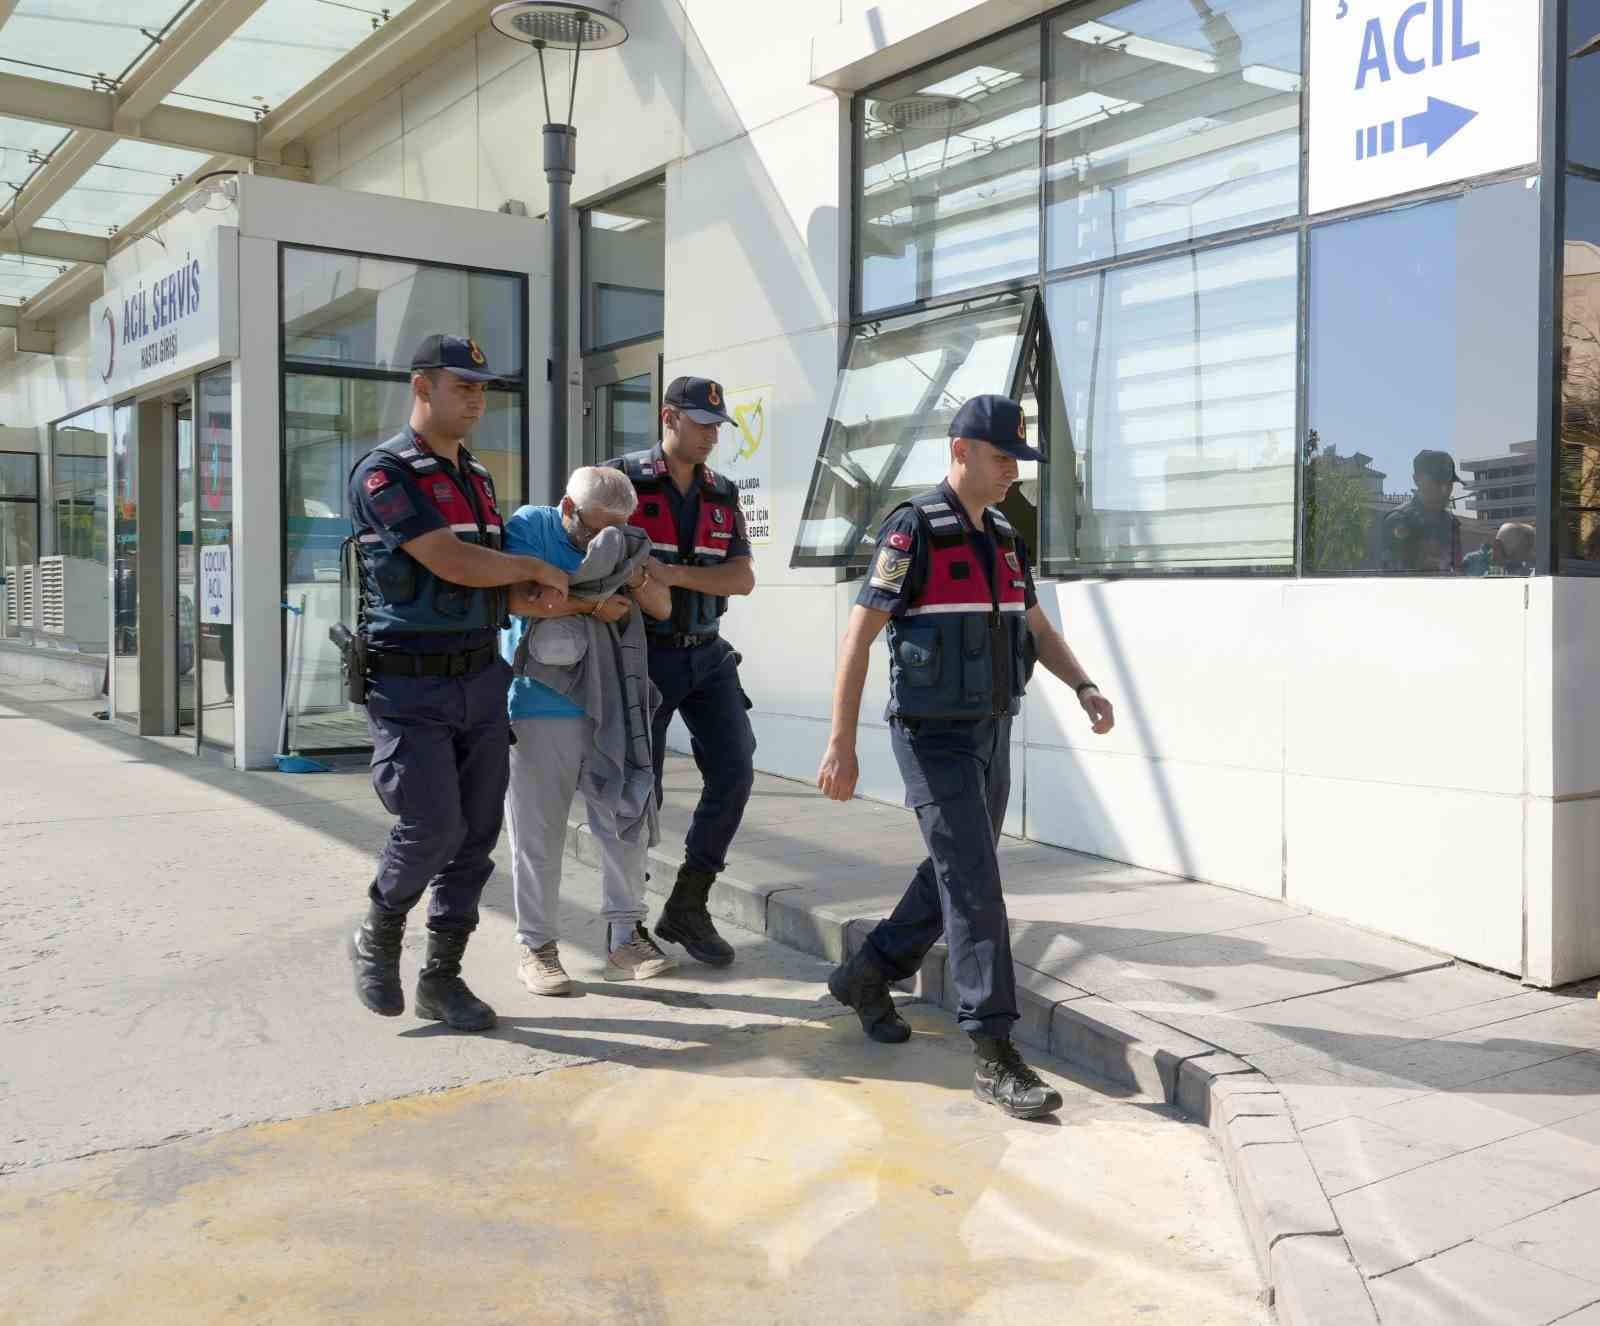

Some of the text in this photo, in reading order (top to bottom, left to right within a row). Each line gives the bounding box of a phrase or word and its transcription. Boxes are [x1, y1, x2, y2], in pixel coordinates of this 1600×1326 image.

[123, 251, 200, 345] ACİL SERVİS
[141, 342, 158, 369] HASTA
[741, 494, 754, 506] ARA
